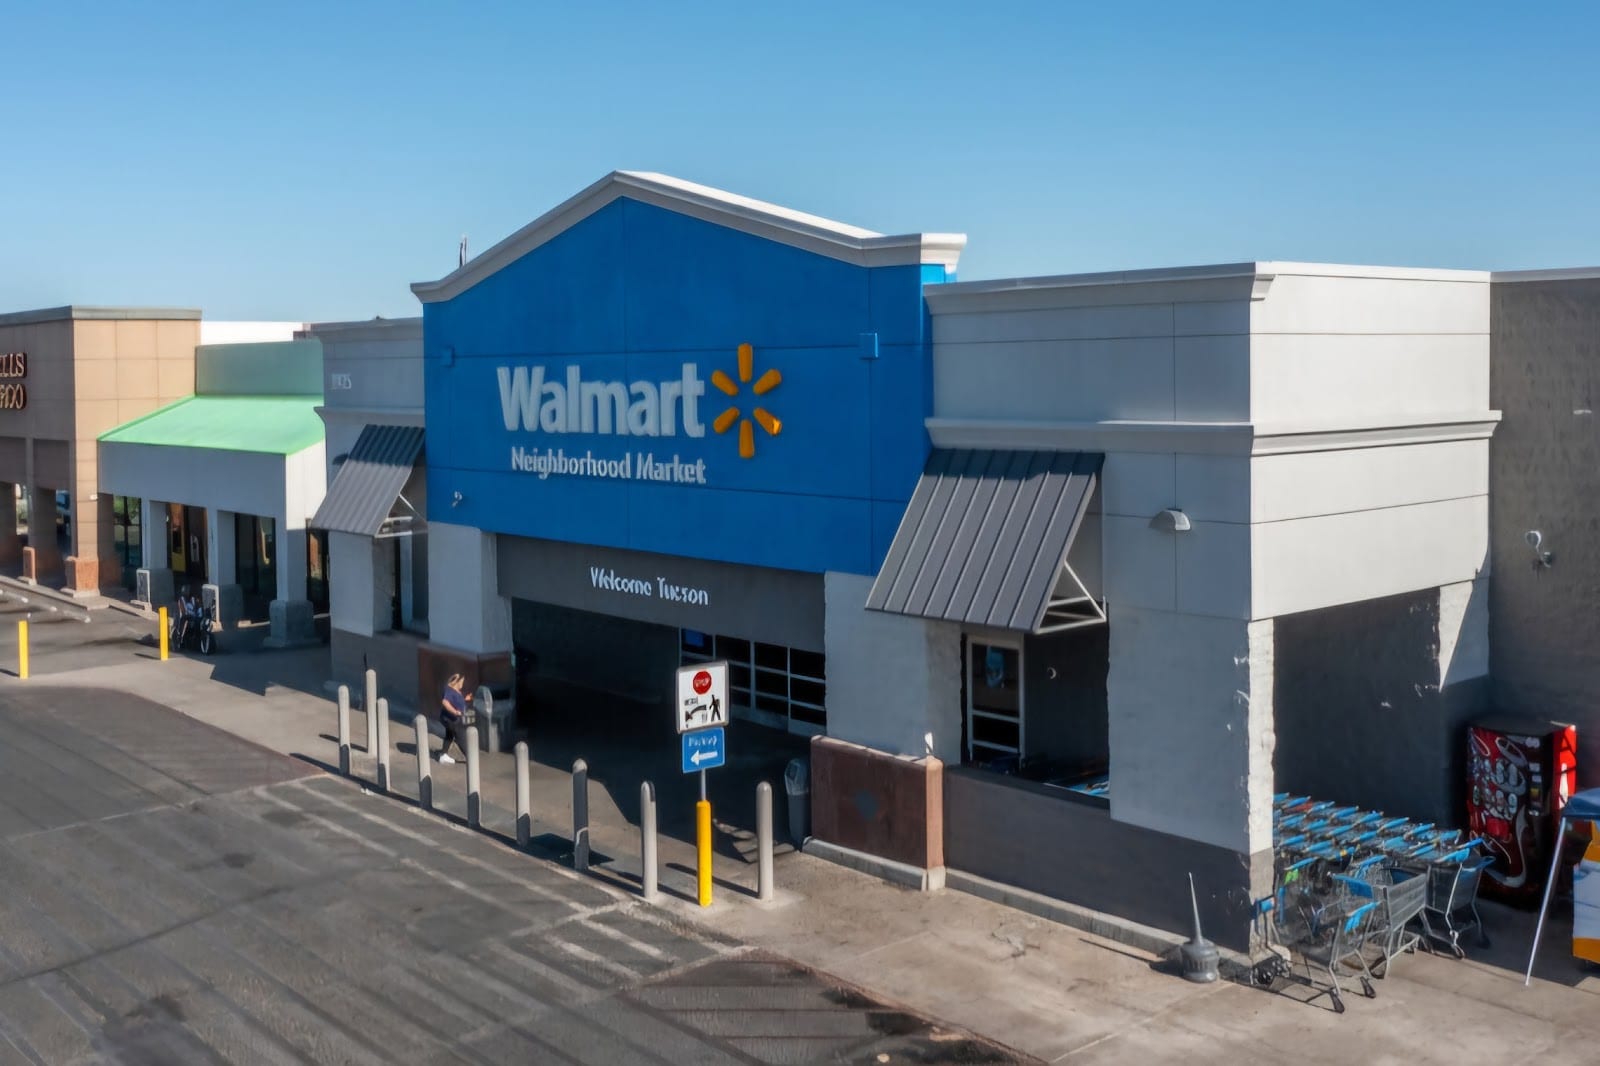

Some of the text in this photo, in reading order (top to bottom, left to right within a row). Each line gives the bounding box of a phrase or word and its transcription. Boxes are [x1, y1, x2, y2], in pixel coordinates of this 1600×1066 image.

[496, 363, 706, 438] Walmart
[511, 446, 707, 484] Neighborhood Market
[590, 566, 709, 606] Welcome Tucson
